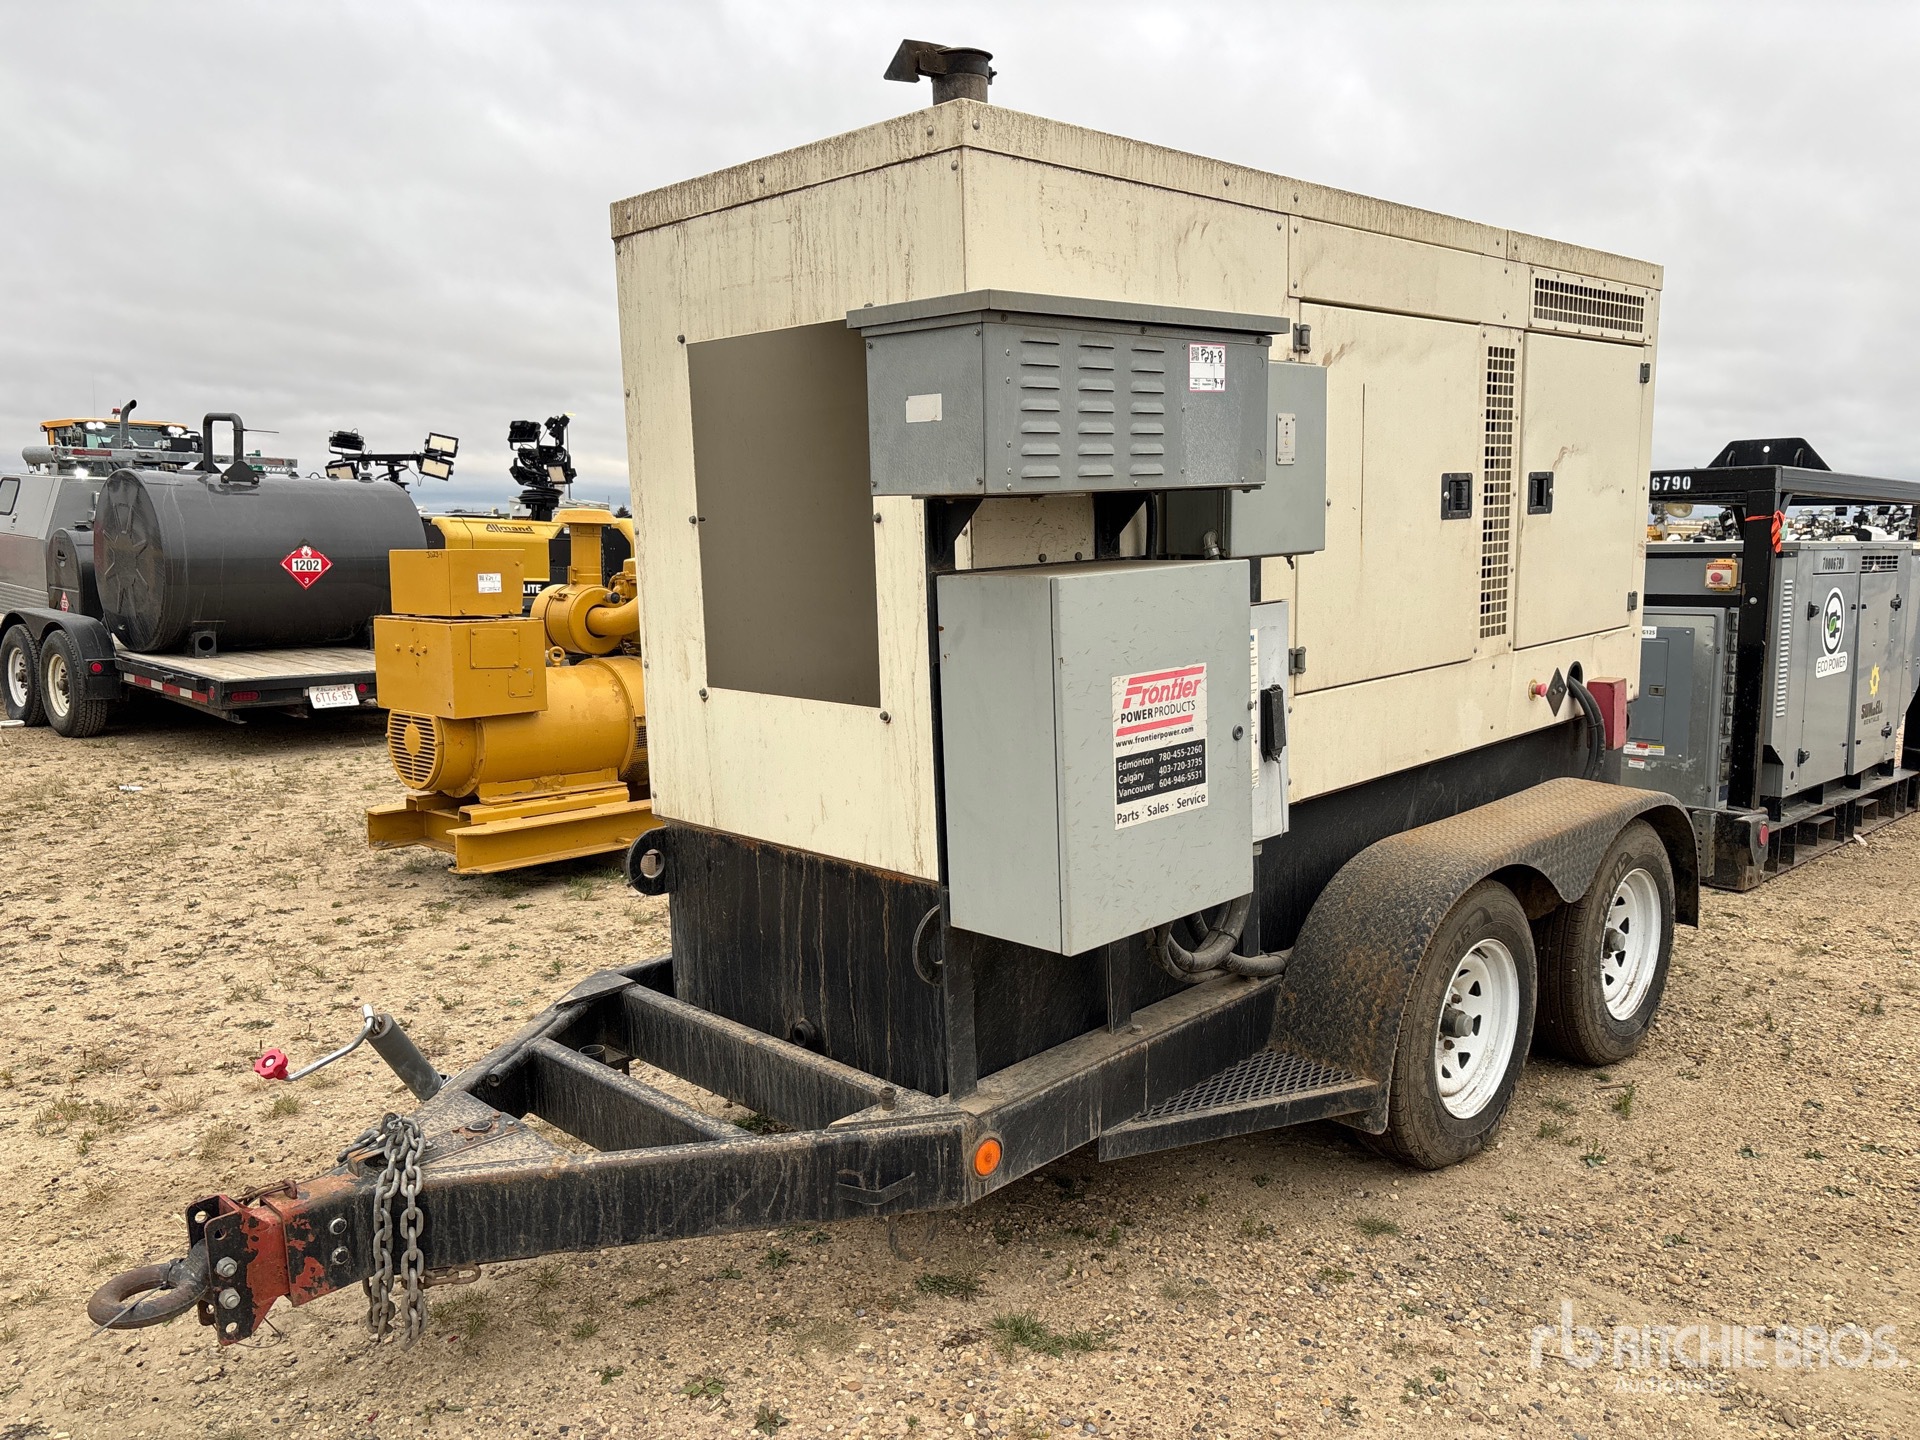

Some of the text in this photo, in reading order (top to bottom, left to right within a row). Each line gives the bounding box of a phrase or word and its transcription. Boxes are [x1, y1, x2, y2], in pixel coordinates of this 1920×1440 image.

[1651, 475, 1692, 492] 6790
[486, 523, 535, 534] Allmand
[293, 559, 320, 571] 1202
[1816, 655, 1847, 673] ECO POWER
[315, 690, 354, 703] 6TT6-85
[1122, 678, 1202, 709] Frontier
[1115, 726, 1194, 748] www.frontierpower.com
[1118, 744, 1203, 771] Edmonton 780-455-2260
[1118, 757, 1203, 785] Calgary 403-720-3735
[1118, 770, 1203, 798] Vancouver 604-946-5531
[1116, 793, 1206, 825] Parts Sales Service
